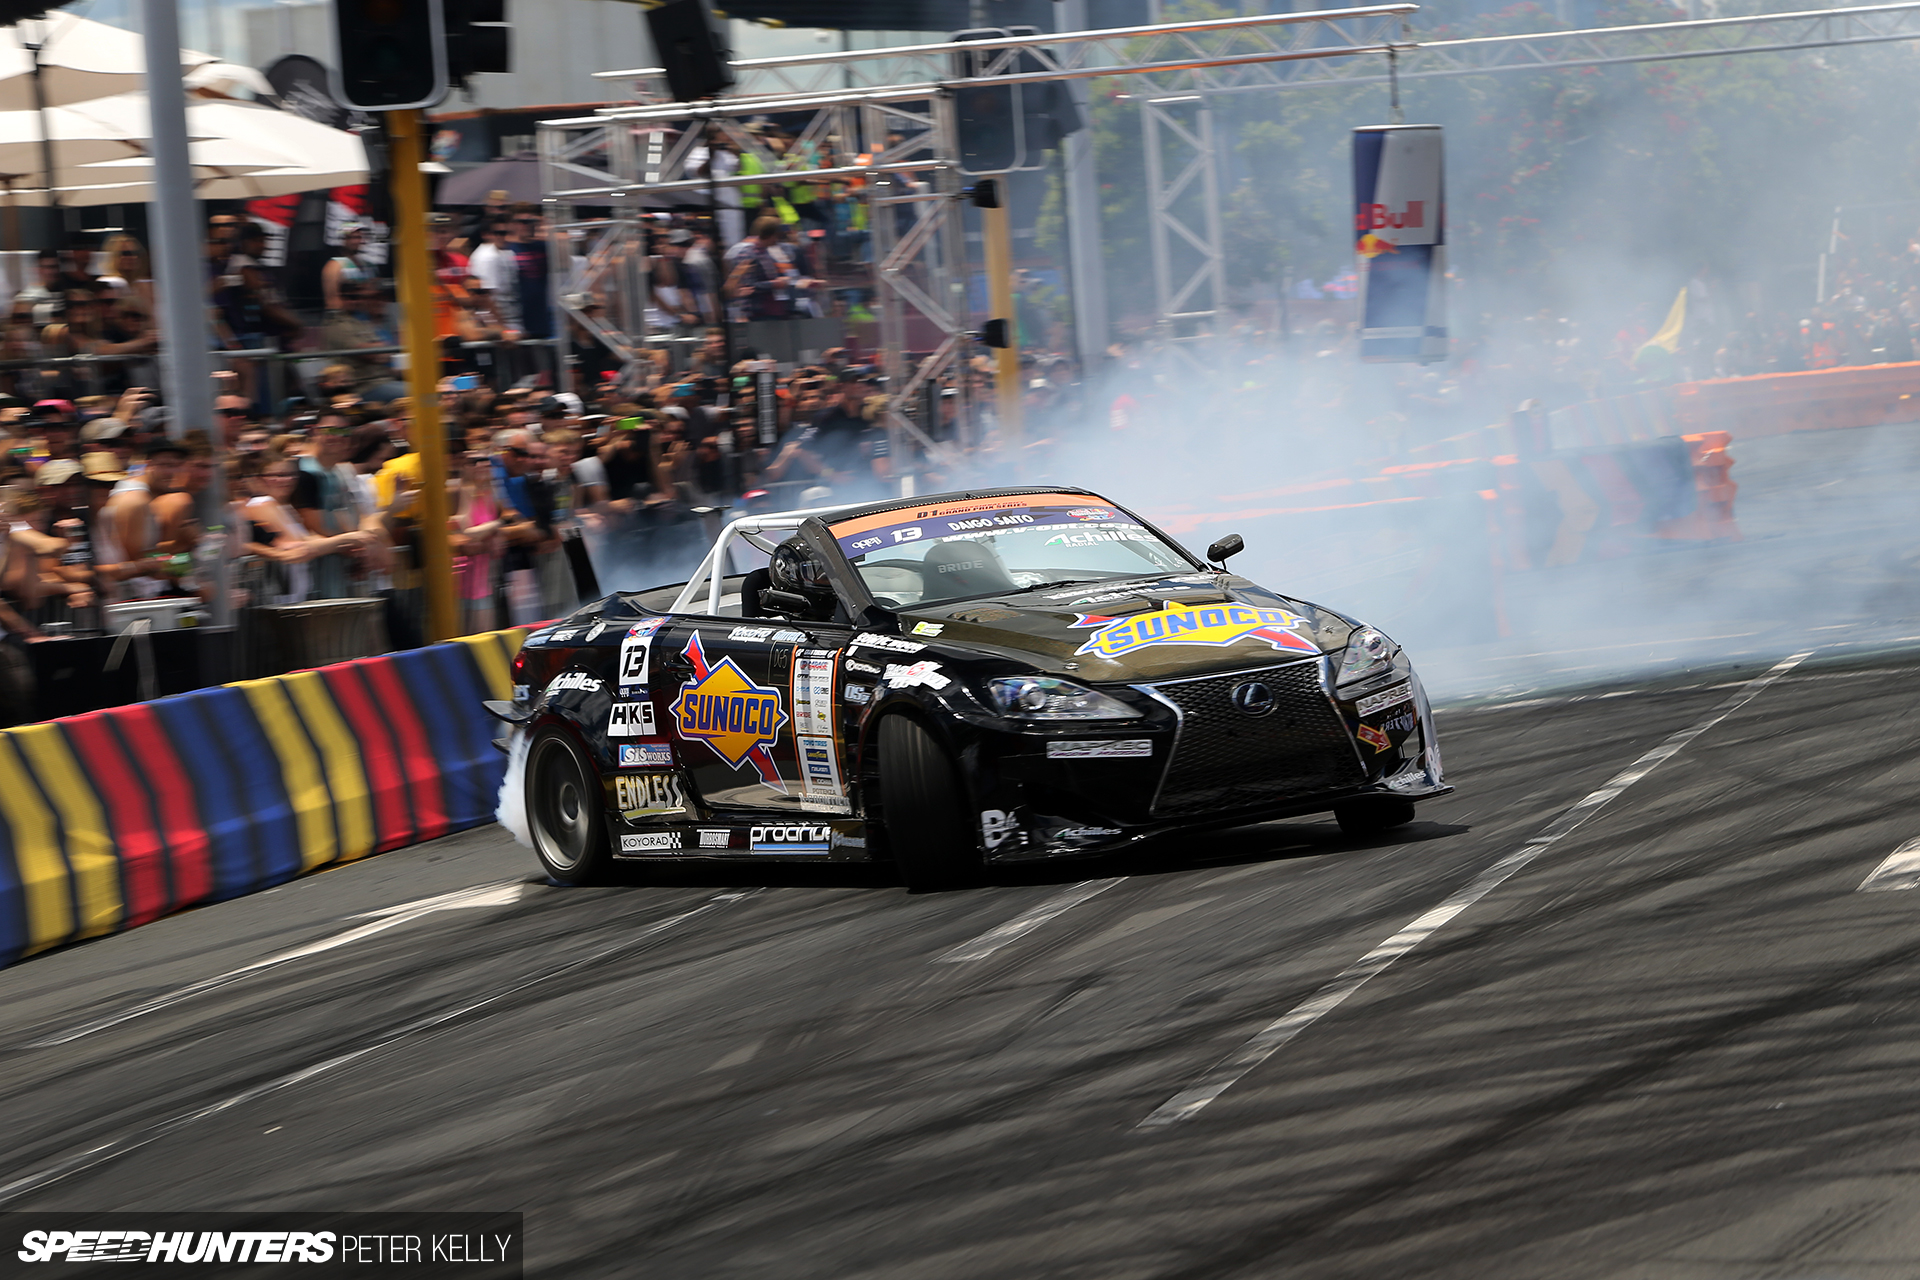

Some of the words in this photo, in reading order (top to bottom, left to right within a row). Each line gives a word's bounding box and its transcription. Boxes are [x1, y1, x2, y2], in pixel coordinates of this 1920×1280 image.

[1372, 201, 1424, 229] Bull
[890, 526, 923, 543] 13
[947, 519, 993, 532] DAIGO
[993, 514, 1035, 526] SAITO
[1044, 530, 1160, 547] Achilles
[1065, 540, 1099, 548] RADIAL
[937, 559, 984, 574] BRIDE
[1107, 607, 1286, 650] SUNOCO
[622, 644, 647, 678] 13
[611, 704, 653, 725] HKS
[683, 693, 775, 735] SUNOCO
[1388, 769, 1427, 789] Achilles
[615, 775, 683, 809] ENDLESS
[622, 836, 669, 847] KOYORAD
[1053, 827, 1122, 838] Achilles
